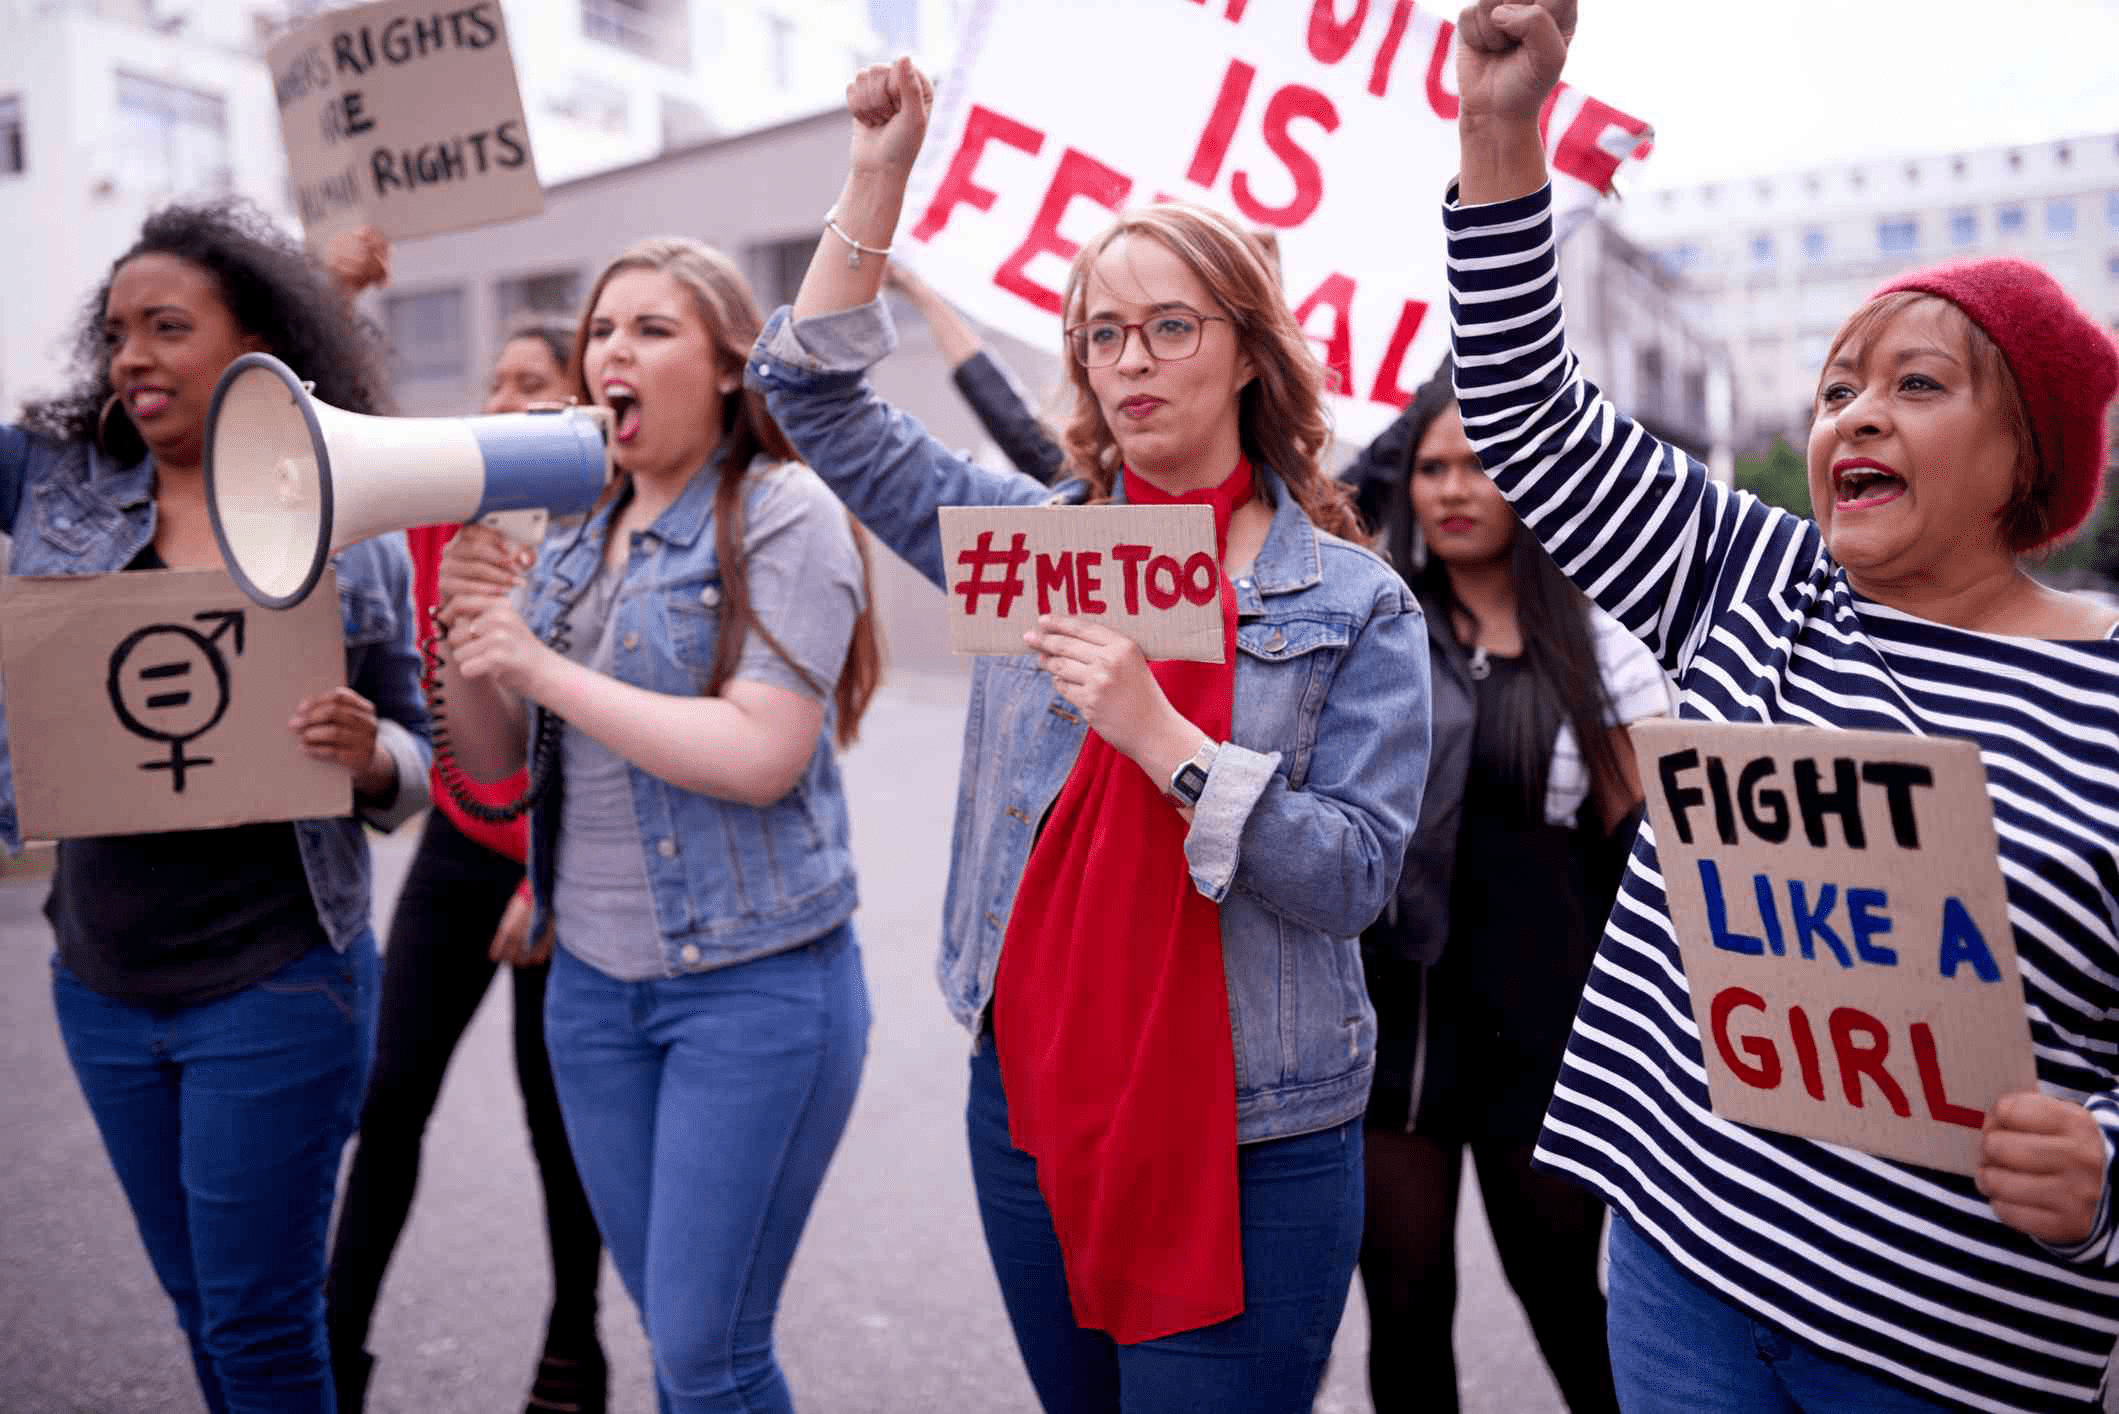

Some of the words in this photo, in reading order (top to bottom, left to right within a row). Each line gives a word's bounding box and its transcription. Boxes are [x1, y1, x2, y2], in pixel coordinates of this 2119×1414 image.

[332, 2, 498, 75] RIGHTS
[370, 120, 527, 197] RIGHTS
[1186, 58, 1340, 228] IS
[1658, 748, 1934, 850] FIGHT
[1697, 859, 1898, 968] LIKE
[1939, 897, 2002, 982] A
[1711, 986, 1985, 1129] GIRL
